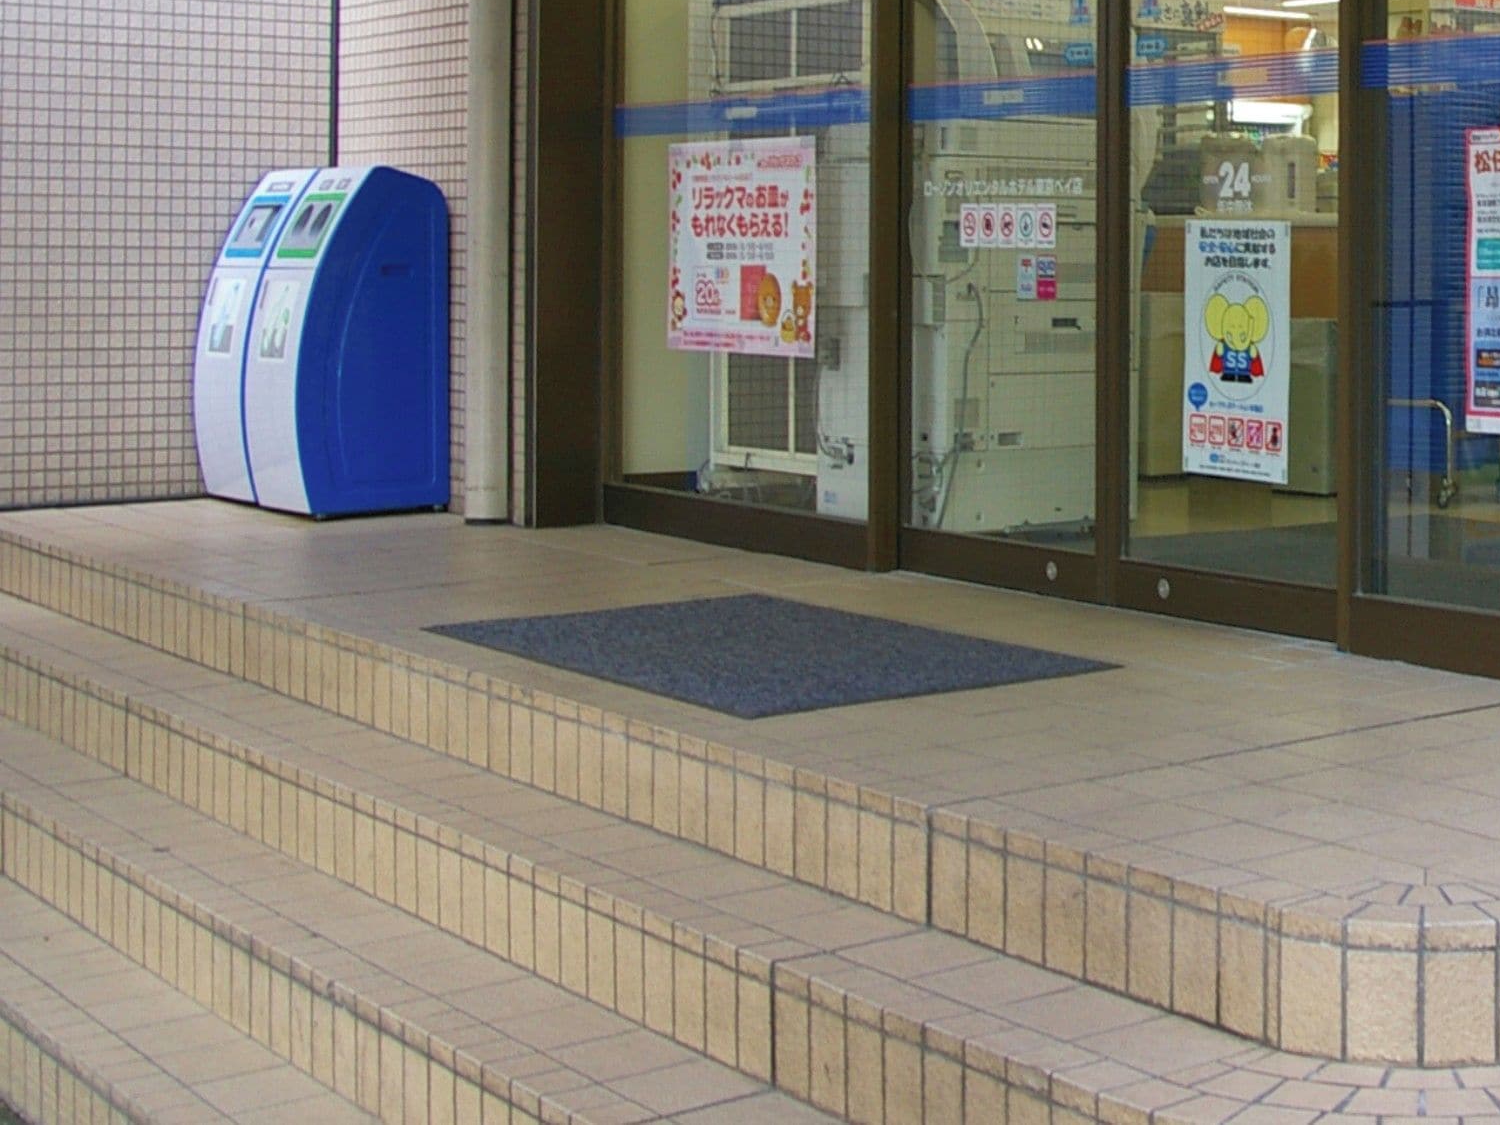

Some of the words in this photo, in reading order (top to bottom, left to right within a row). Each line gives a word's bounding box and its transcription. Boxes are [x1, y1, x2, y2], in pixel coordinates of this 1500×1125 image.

[1219, 161, 1251, 198] 24
[692, 185, 790, 211] リラックマのお皿が
[691, 211, 790, 238] もれなくもらえる!
[1226, 351, 1248, 368] SS
